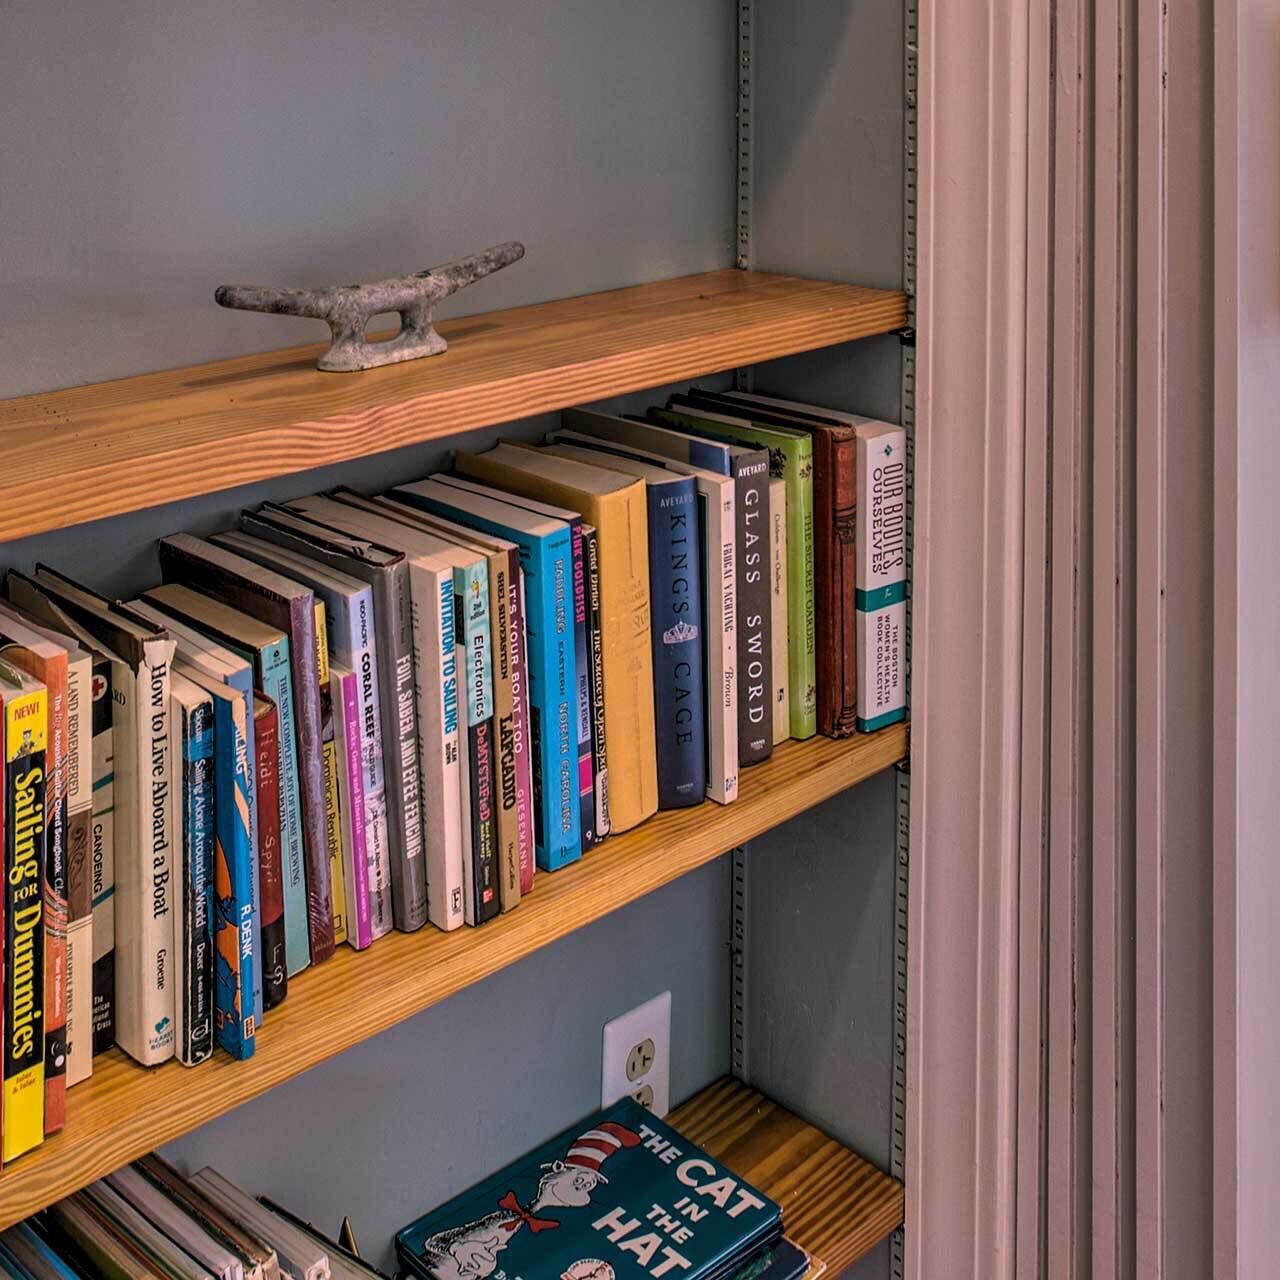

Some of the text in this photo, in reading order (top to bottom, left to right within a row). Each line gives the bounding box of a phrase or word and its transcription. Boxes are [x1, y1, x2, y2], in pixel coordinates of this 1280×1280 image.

[738, 462, 767, 479] AVEYARD
[883, 462, 904, 571] OUR BODIES
[572, 526, 585, 624] PINK GOLDFISH
[744, 488, 761, 584] GLASS
[803, 512, 815, 655] THE SECRET GARDEN
[441, 579, 458, 735] INVITATION TO SAILING
[474, 635, 486, 718] Electronics
[497, 572, 508, 680] SHEL SILVERSTEIN
[670, 511, 693, 745] KING'S CAGE
[723, 583, 735, 708] YACHTING Brown
[746, 615, 764, 724] SWORD
[14, 703, 40, 720] NEW!
[68, 679, 80, 796] LAND REMEMBERED
[365, 704, 375, 739] REEF
[509, 621, 524, 754] YOUR BOAT TOO
[323, 748, 337, 860] Dominican Republic
[400, 741, 421, 858] AND FENCING
[500, 712, 516, 810] LAFCADIO
[559, 701, 571, 833] NORTH CAROLINA
[93, 824, 102, 893] CANOEING
[151, 663, 169, 989] How to Live Aboard a Boat Groene
[195, 759, 206, 927] Sailing Alone Around the World
[517, 789, 528, 870] GIESEMANN
[9, 767, 43, 1060] Sailing FOR Dummies
[240, 920, 253, 960] DENK
[638, 1123, 683, 1164] THE
[675, 1159, 765, 1219] CAT
[591, 1206, 692, 1279] HAT
[646, 1203, 695, 1245] THE
[674, 1196, 710, 1223] IN
